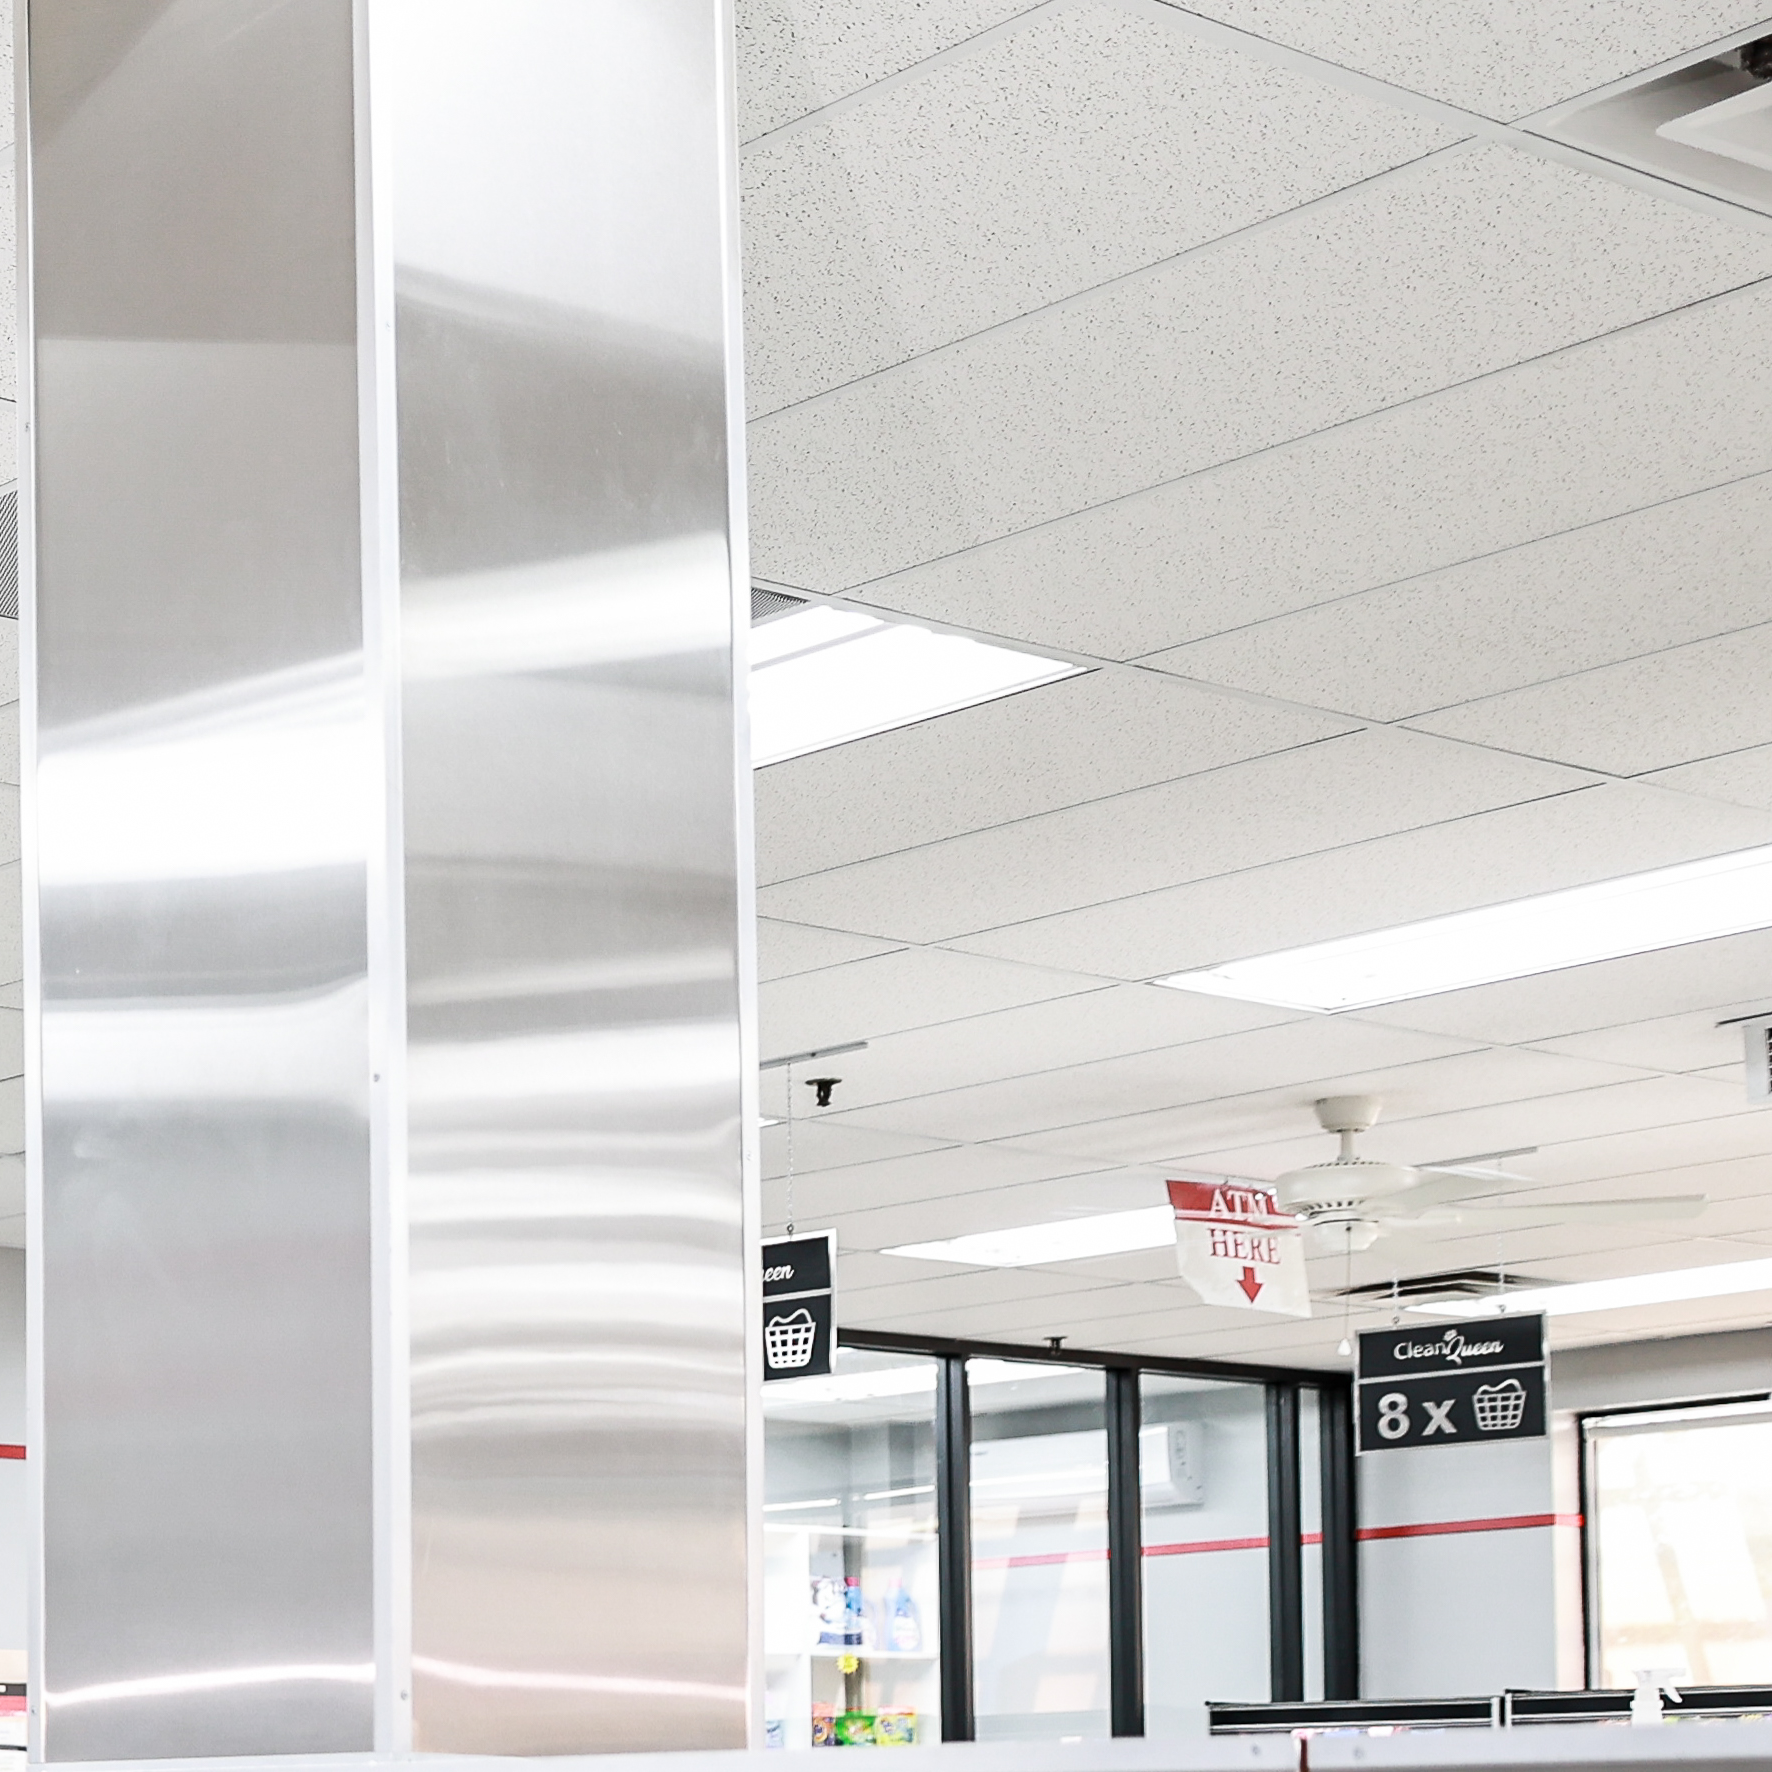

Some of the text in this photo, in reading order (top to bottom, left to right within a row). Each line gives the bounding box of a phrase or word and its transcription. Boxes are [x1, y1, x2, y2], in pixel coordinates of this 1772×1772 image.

[1209, 1188, 1269, 1222] ATM
[1207, 1228, 1281, 1265] HERE
[1377, 1392, 1457, 1440] 8 x
